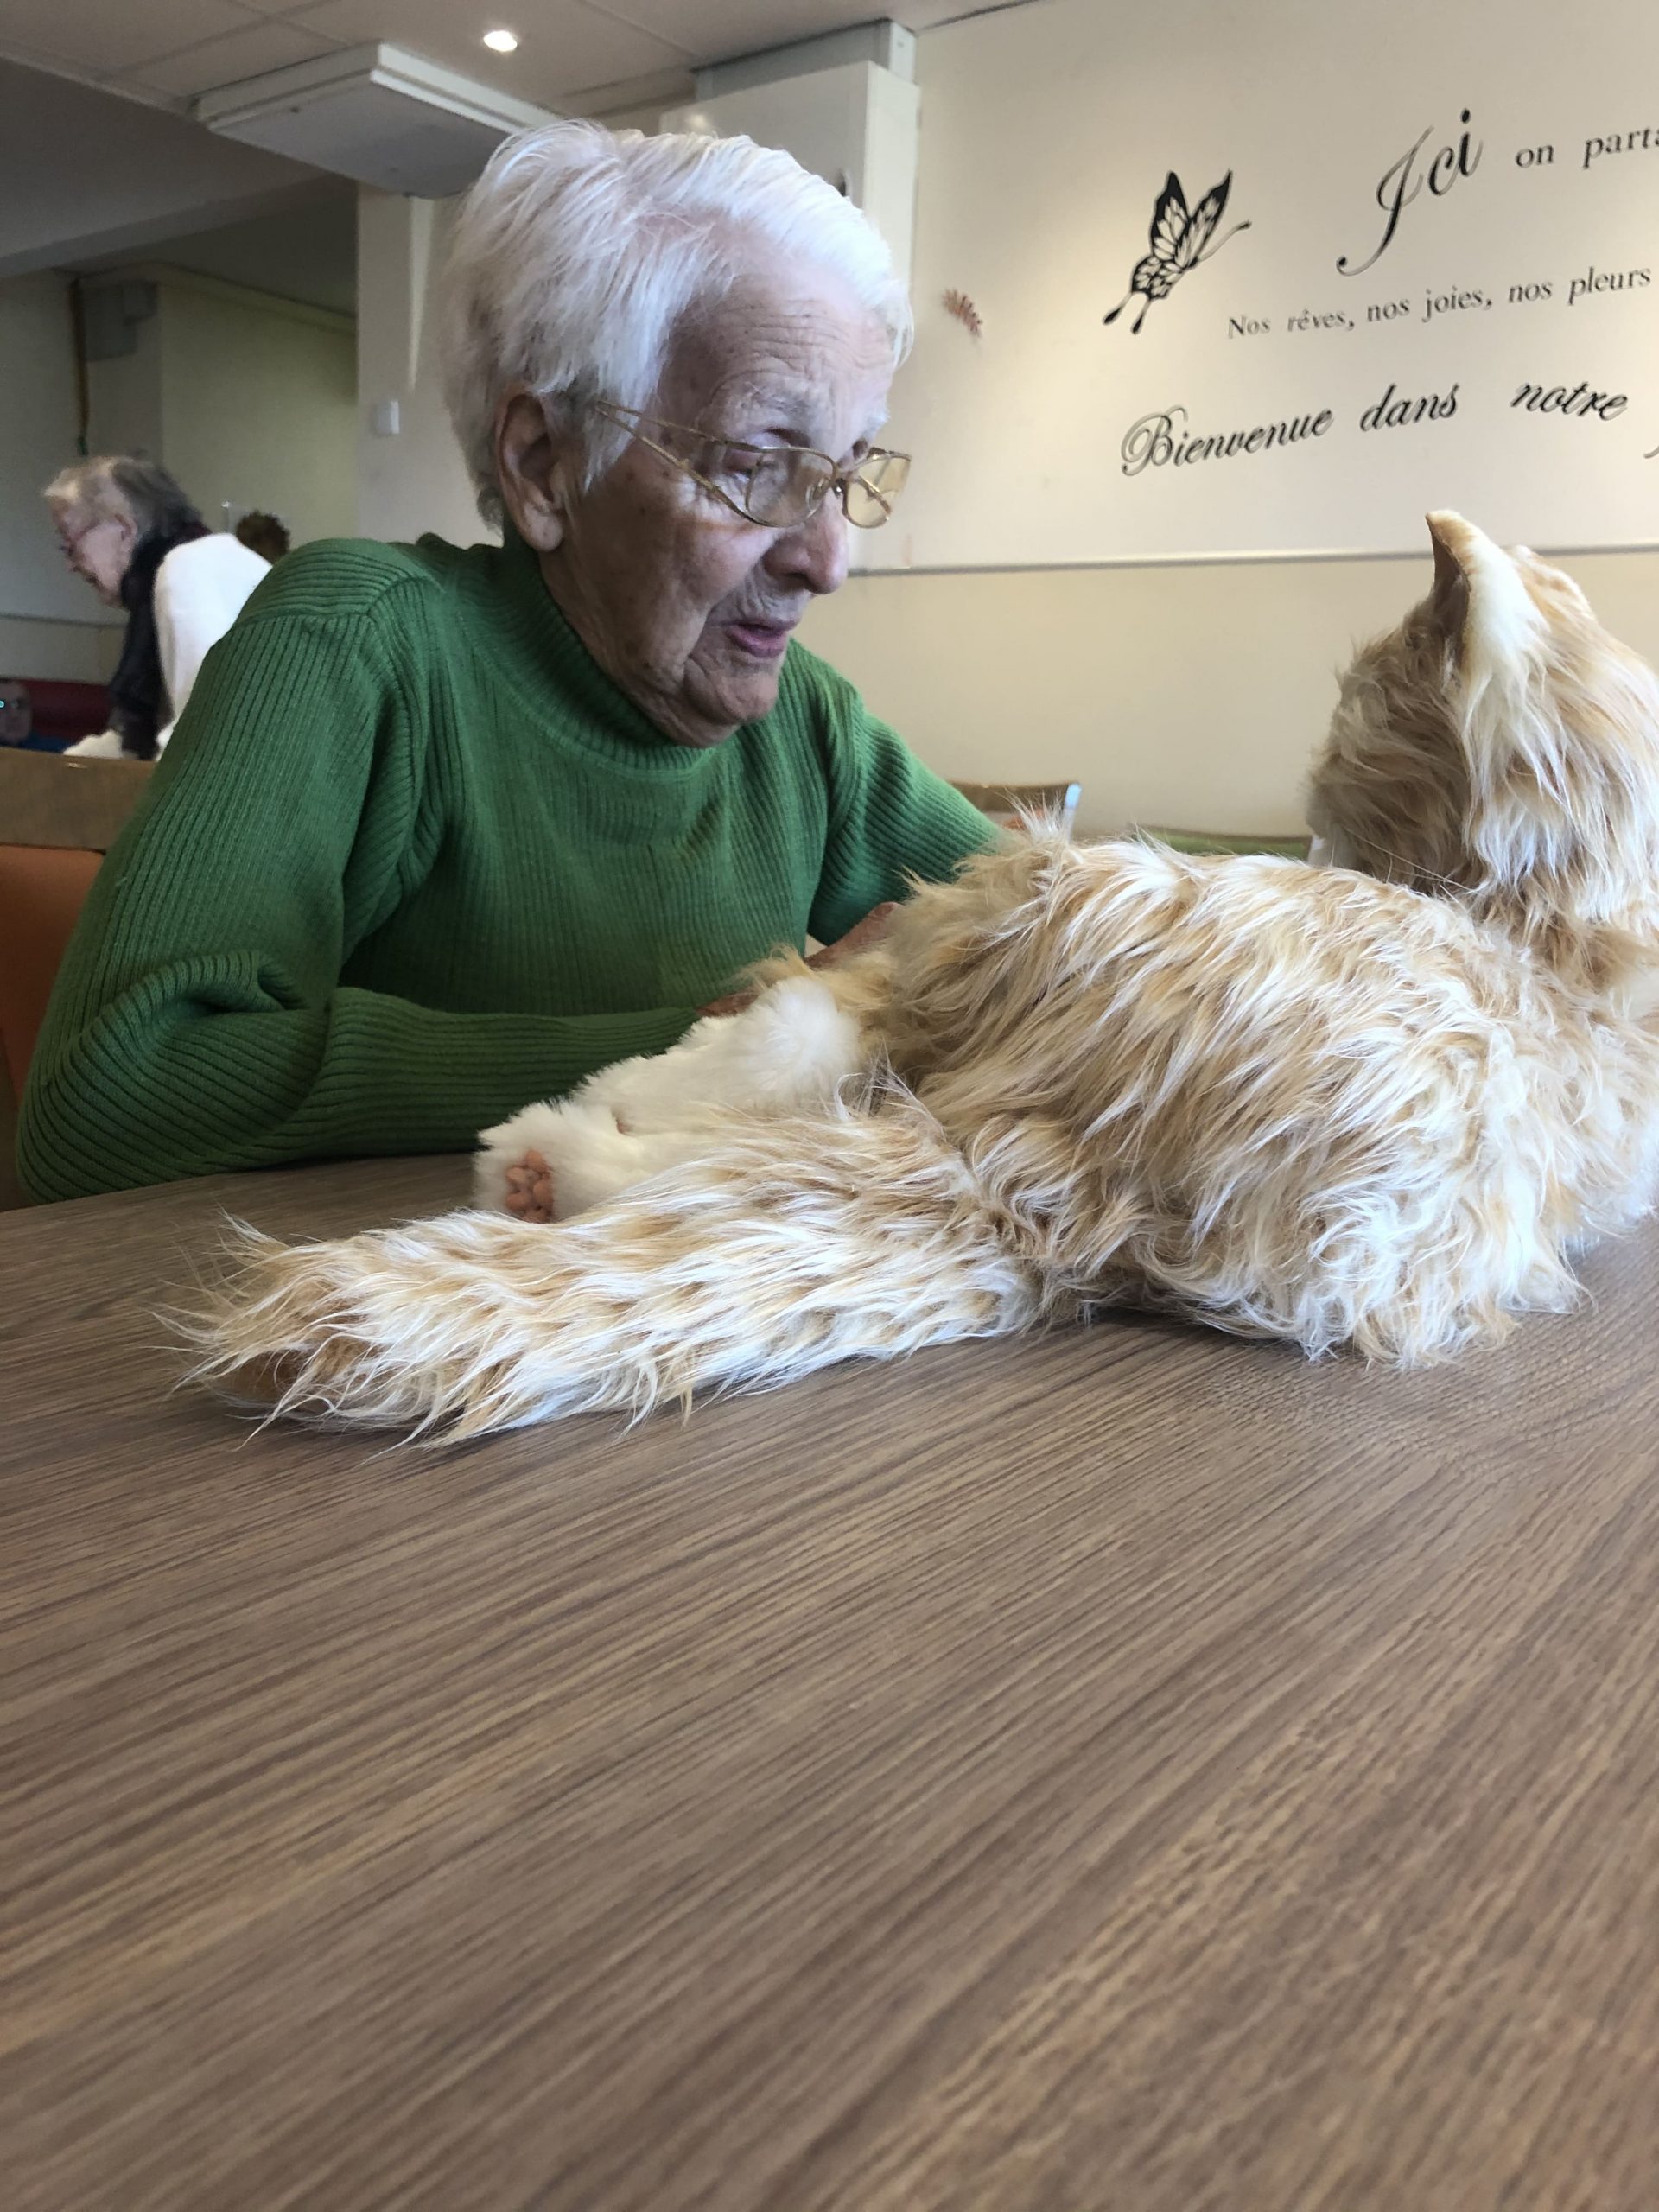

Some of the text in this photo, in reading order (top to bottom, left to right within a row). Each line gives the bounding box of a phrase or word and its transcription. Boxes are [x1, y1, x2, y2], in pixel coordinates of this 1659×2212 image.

[1515, 144, 1554, 168] on
[1228, 265, 1651, 339] Nos rêves, nos joies, nos pleurs
[1121, 380, 1629, 477] Bienvenue dans notre
